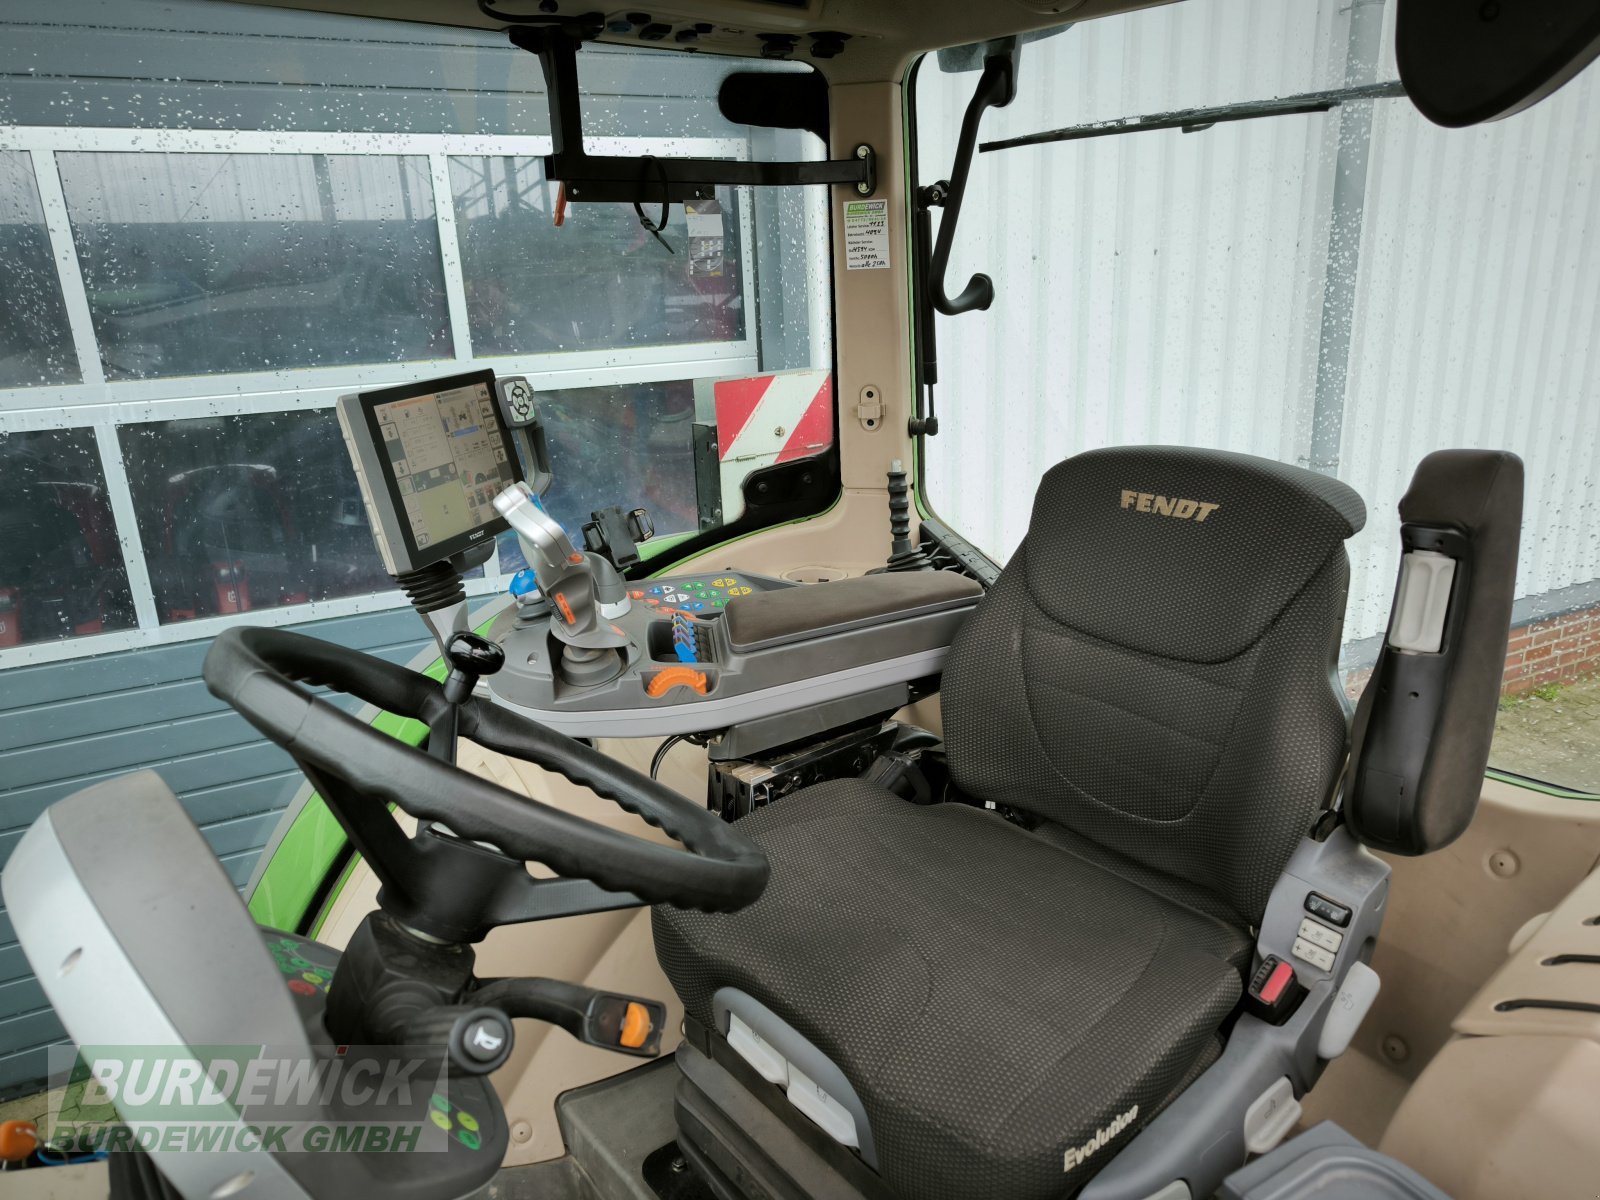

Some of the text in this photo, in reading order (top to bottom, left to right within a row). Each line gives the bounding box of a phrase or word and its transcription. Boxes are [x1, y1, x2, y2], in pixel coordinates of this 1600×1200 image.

[849, 203, 884, 211] BURDEWICK
[1120, 489, 1220, 522] FENDT
[1063, 1104, 1139, 1173] Evolution
